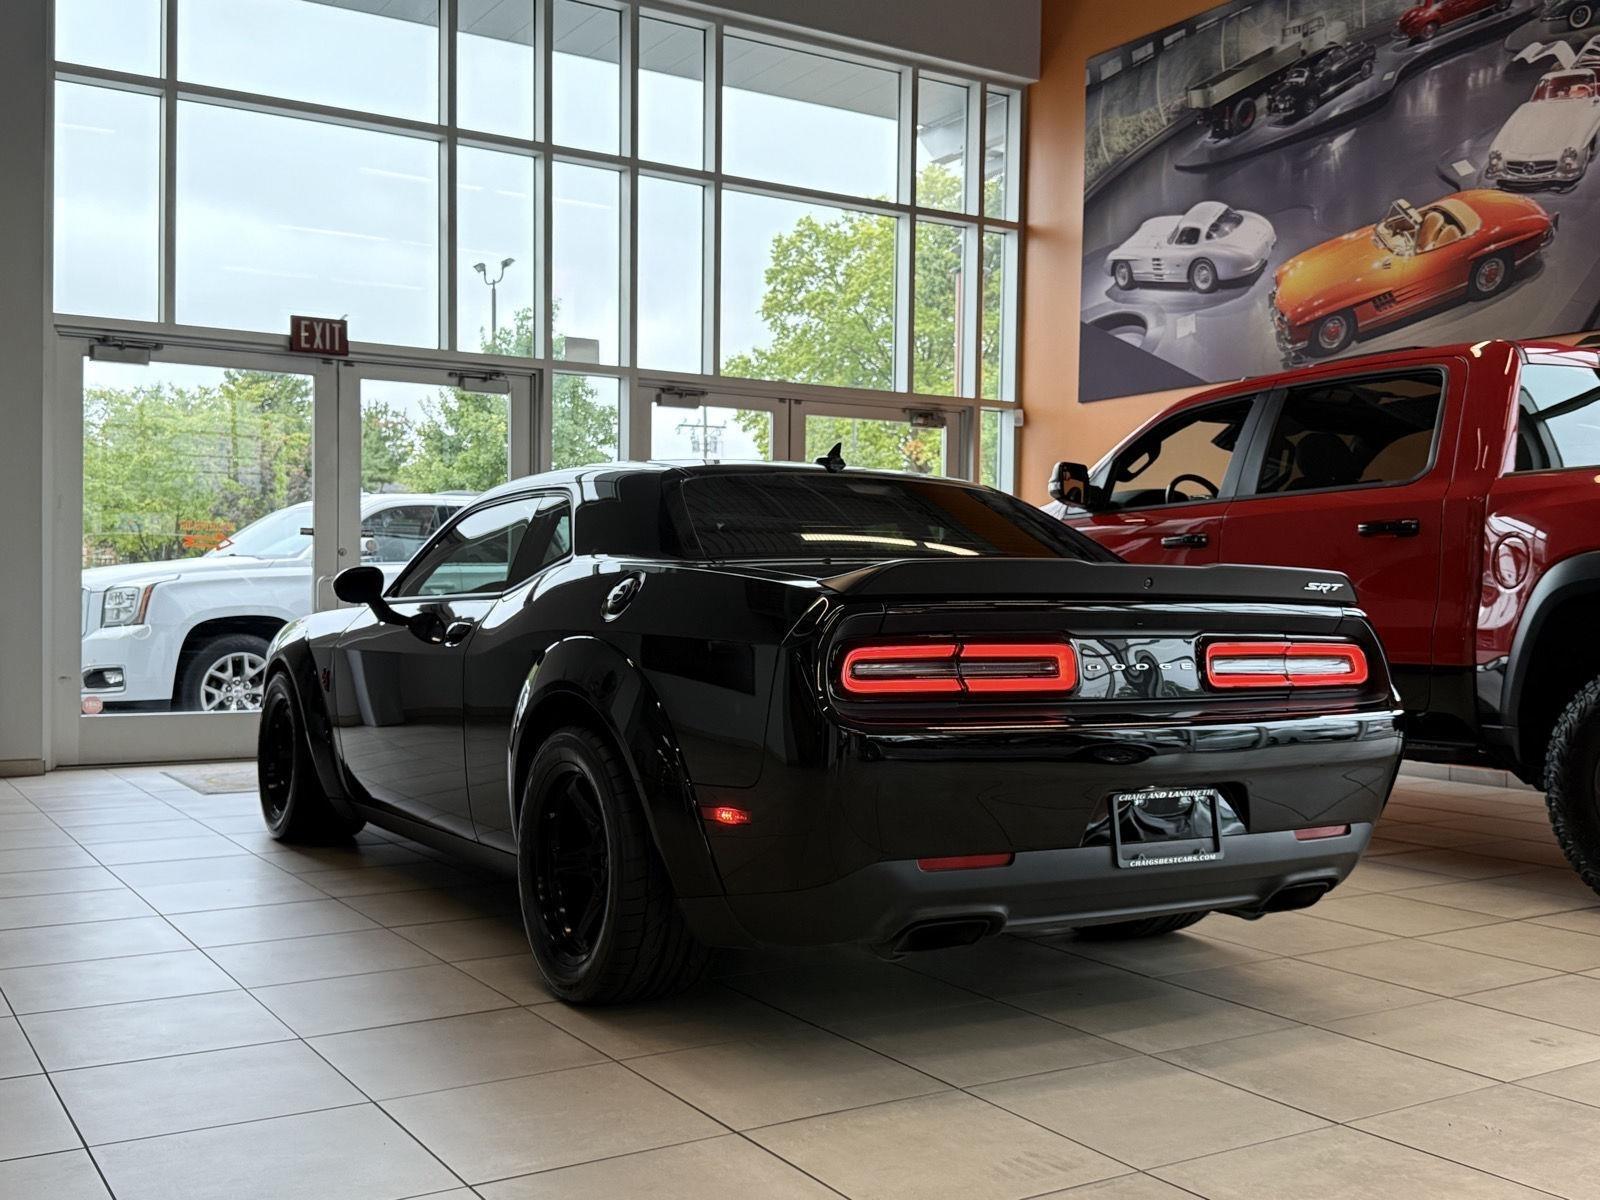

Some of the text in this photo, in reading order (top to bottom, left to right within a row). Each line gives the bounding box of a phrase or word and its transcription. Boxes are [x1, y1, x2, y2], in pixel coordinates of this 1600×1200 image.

[300, 320, 342, 351] EXIT
[1304, 582, 1344, 594] SRT
[1086, 663, 1193, 671] DODGE
[1118, 789, 1214, 801] CRAIG AND LANDRETH
[1130, 854, 1216, 867] CRAIGSBESTCARS.COM
